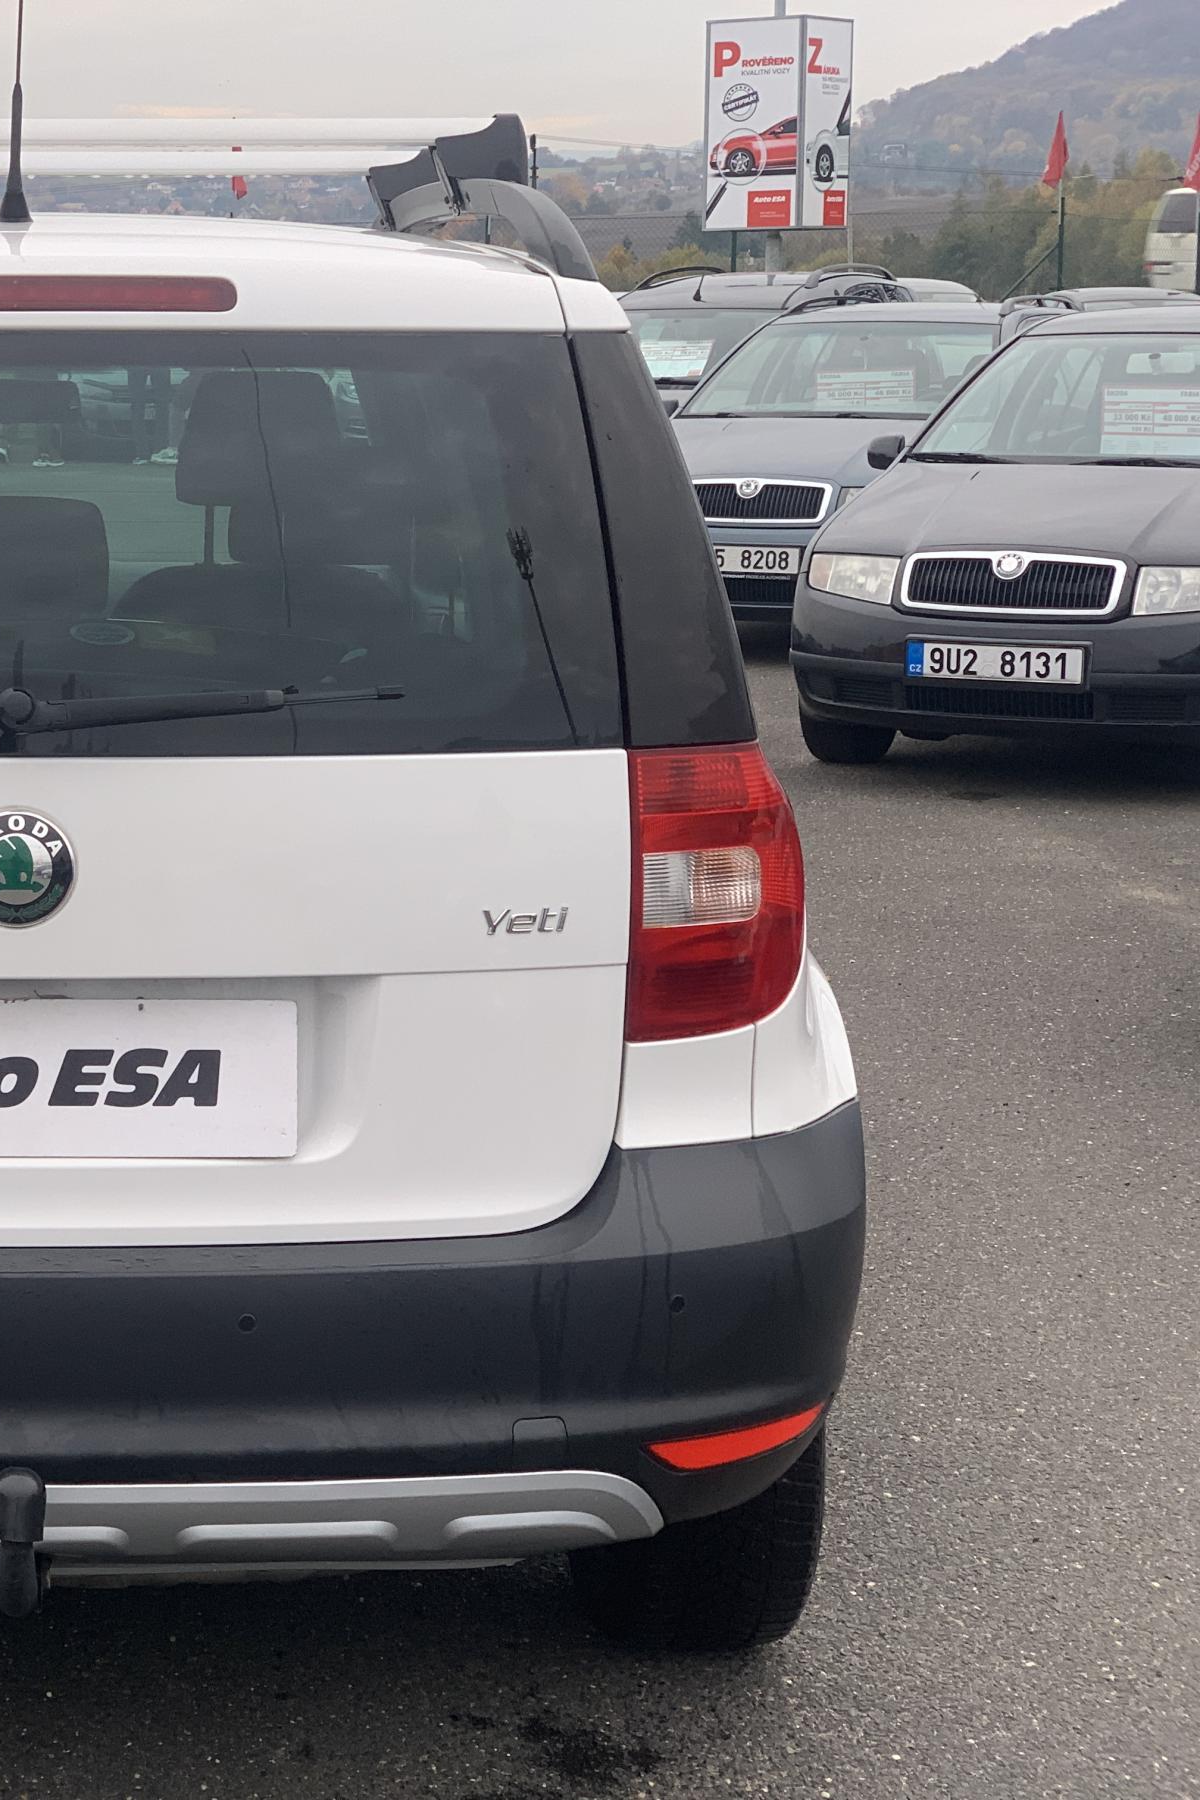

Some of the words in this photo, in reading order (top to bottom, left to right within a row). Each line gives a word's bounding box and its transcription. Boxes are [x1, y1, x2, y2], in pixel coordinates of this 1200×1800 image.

[773, 67, 790, 75] VOZY
[772, 195, 786, 203] ESA
[740, 550, 789, 570] 8208
[909, 663, 922, 673] CZ
[929, 647, 978, 676] 9U2
[1000, 650, 1068, 680] 8131
[482, 906, 568, 935] Yeti
[47, 1047, 221, 1108] ESA
